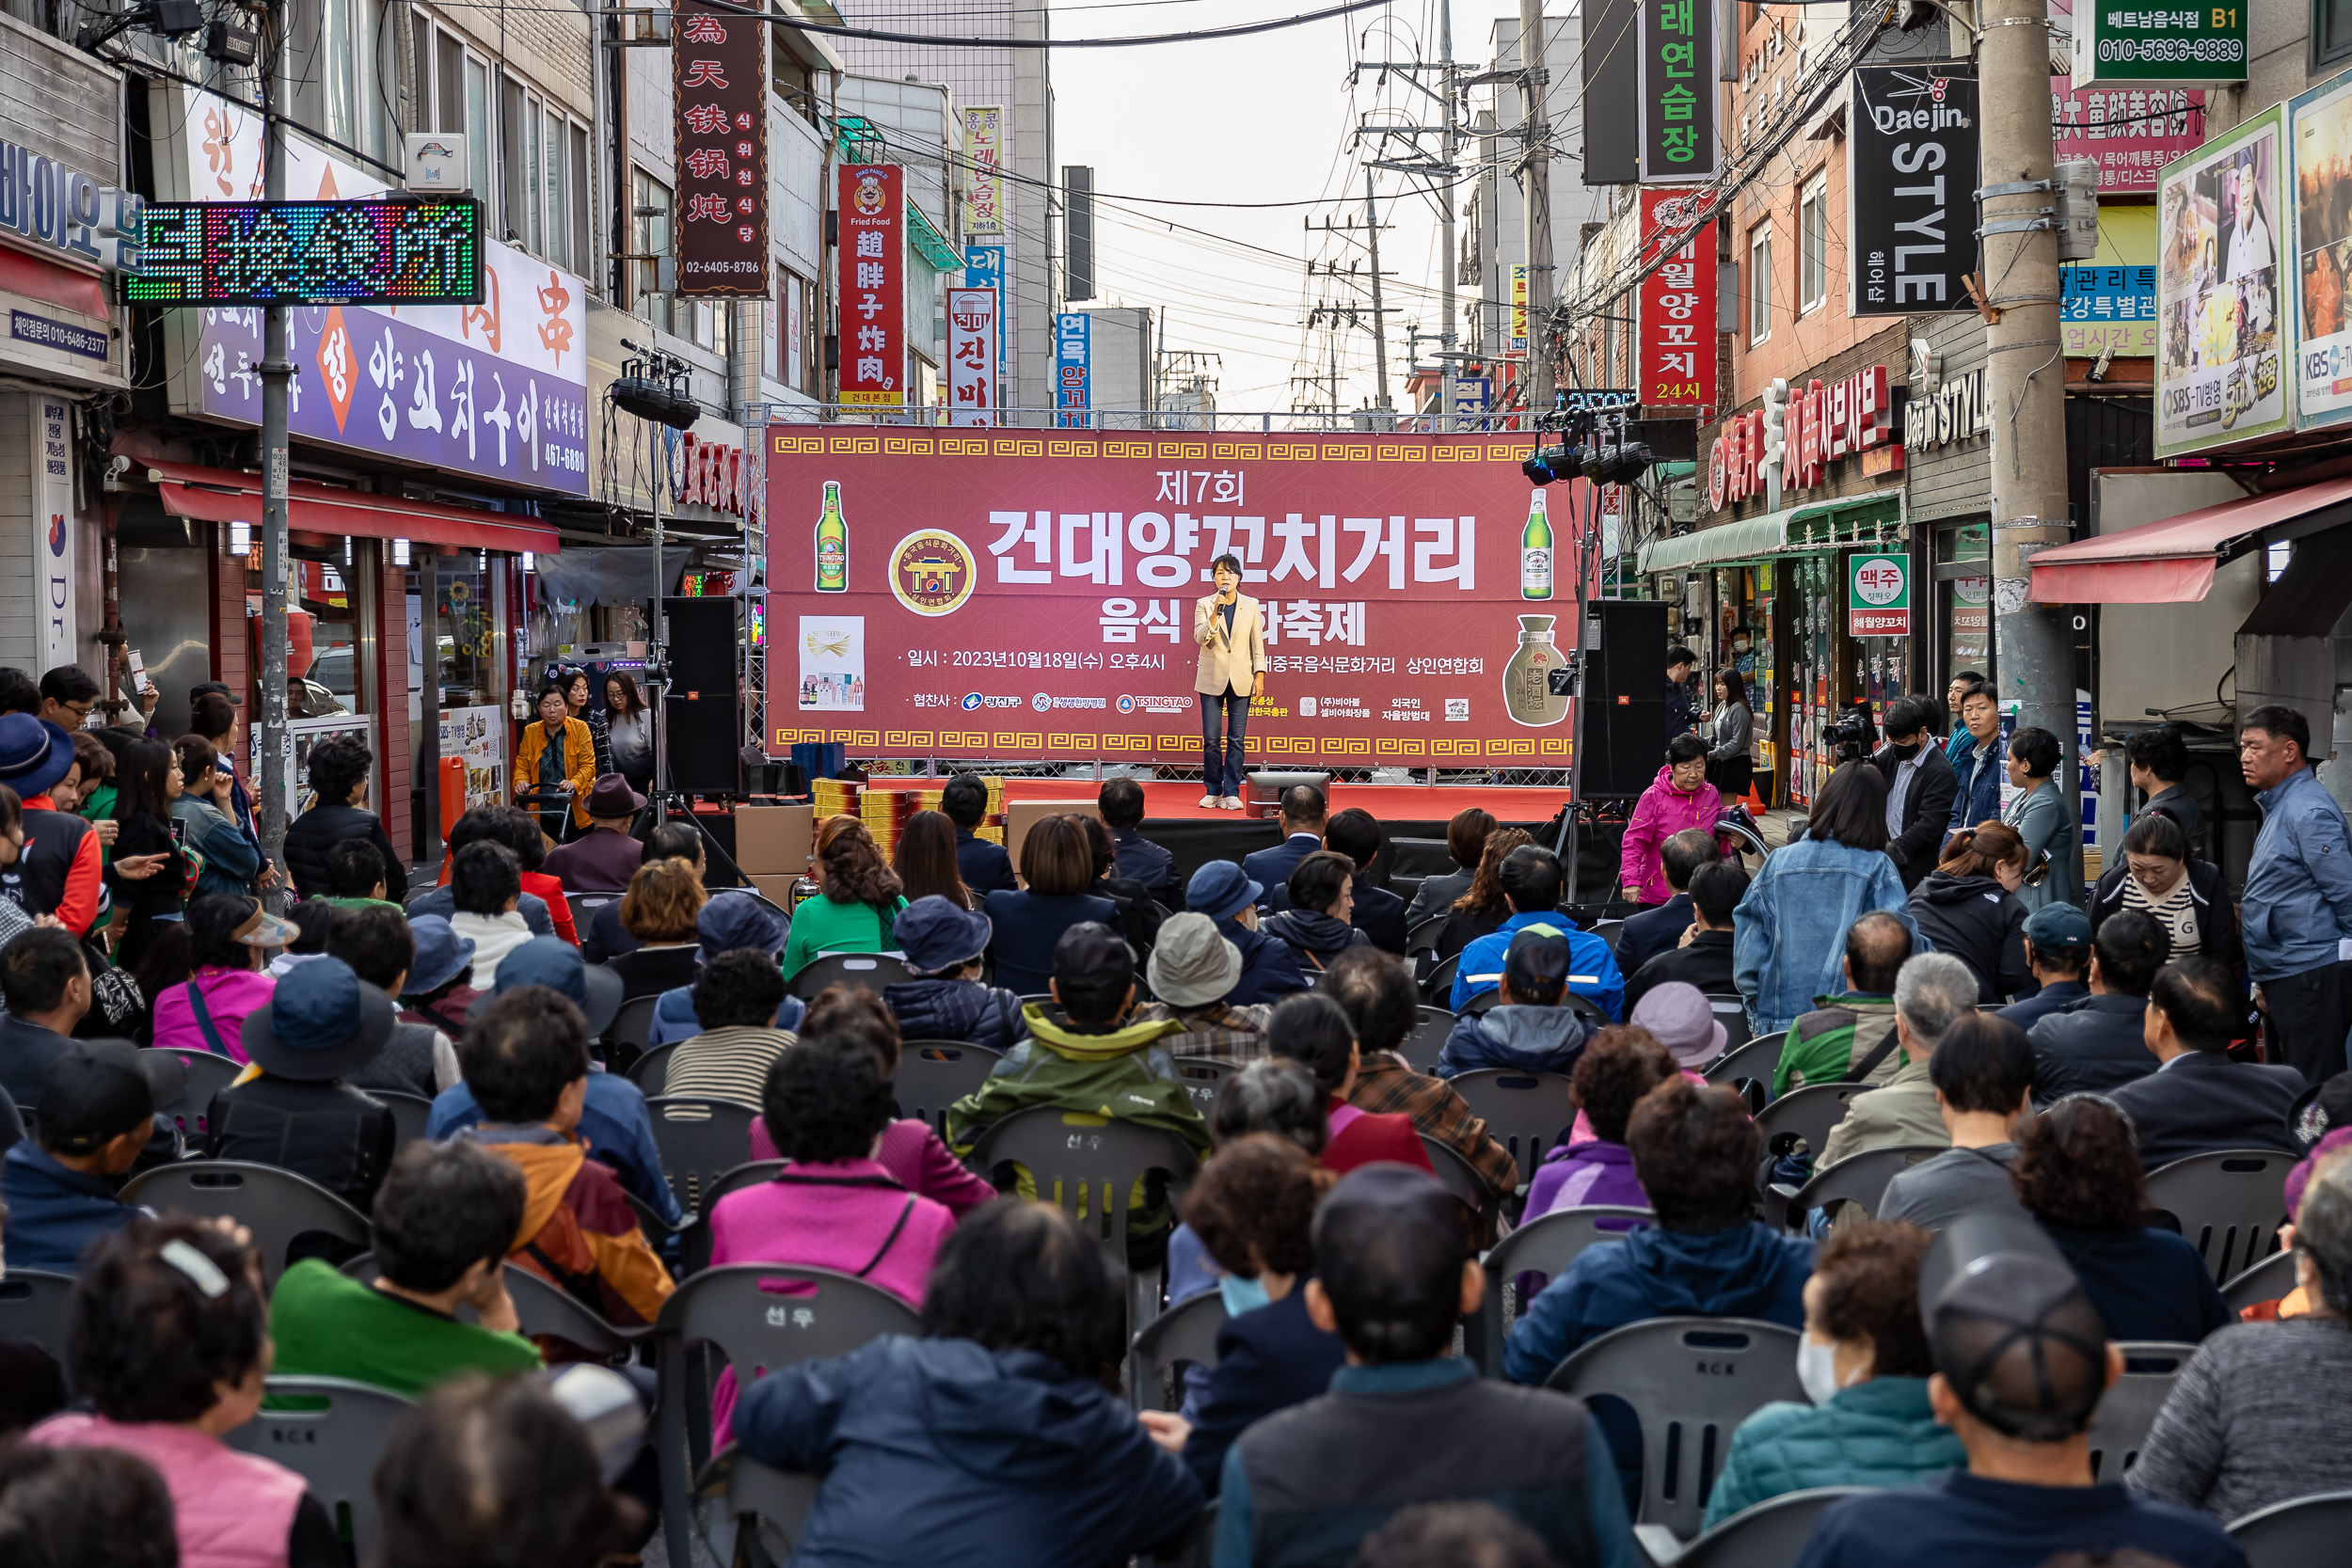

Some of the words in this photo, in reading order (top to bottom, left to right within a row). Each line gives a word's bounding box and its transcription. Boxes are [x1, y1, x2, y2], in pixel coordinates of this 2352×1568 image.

[2107, 10, 2200, 29] 베트남음식점
[2212, 8, 2236, 28] B1
[2098, 39, 2243, 62] 010-5696-9889
[966, 112, 998, 130] 홍콩
[1875, 102, 1963, 133] Daejin
[736, 112, 755, 244] 식위천식당
[973, 131, 996, 218] 노래연습장
[850, 217, 870, 226] Fried
[871, 217, 890, 226] Food
[972, 221, 997, 230] 지하1층
[1891, 141, 1947, 304] STYLE
[686, 261, 759, 274] 02-6405-8786
[1867, 250, 1885, 303] 헤어샵
[857, 230, 886, 384] 趙胖子炸肉
[957, 314, 987, 329] 진미
[14, 315, 50, 341] 체인점문의
[51, 326, 105, 354] 010-6486-2377
[2306, 350, 2328, 380] KBS
[851, 393, 891, 403] 건대본점
[1656, 382, 1700, 401] 24시
[1820, 364, 1878, 462] 샤브샤브
[1904, 394, 1939, 451] Daejin
[48, 423, 62, 439] 전용
[45, 441, 65, 458] 기능성
[545, 443, 585, 473] 467-6880
[47, 459, 66, 475] 화장품
[1155, 469, 1245, 507] 제7회
[904, 539, 961, 562] 중국음식문화거리
[987, 511, 1475, 591] 건대양꼬치거리
[1860, 569, 1899, 589] 맥주
[912, 593, 953, 607] 상인연합회
[1867, 592, 1892, 601] 칭따오
[51, 574, 67, 650] Dr.
[1853, 616, 1906, 629] 해월양꼬치
[908, 650, 938, 667] 일시
[952, 651, 1104, 670] 2023년10월18일(수)
[1108, 652, 1166, 671] 오후4시
[1406, 657, 1485, 675] 상인연합회
[914, 693, 950, 707] 협찬사
[984, 696, 1022, 707] 광진구
[1136, 695, 1193, 708] TSINGTAO
[1391, 698, 1421, 708] 외국인
[1382, 710, 1430, 721] 자율방범대
[765, 1305, 816, 1329] 선우
